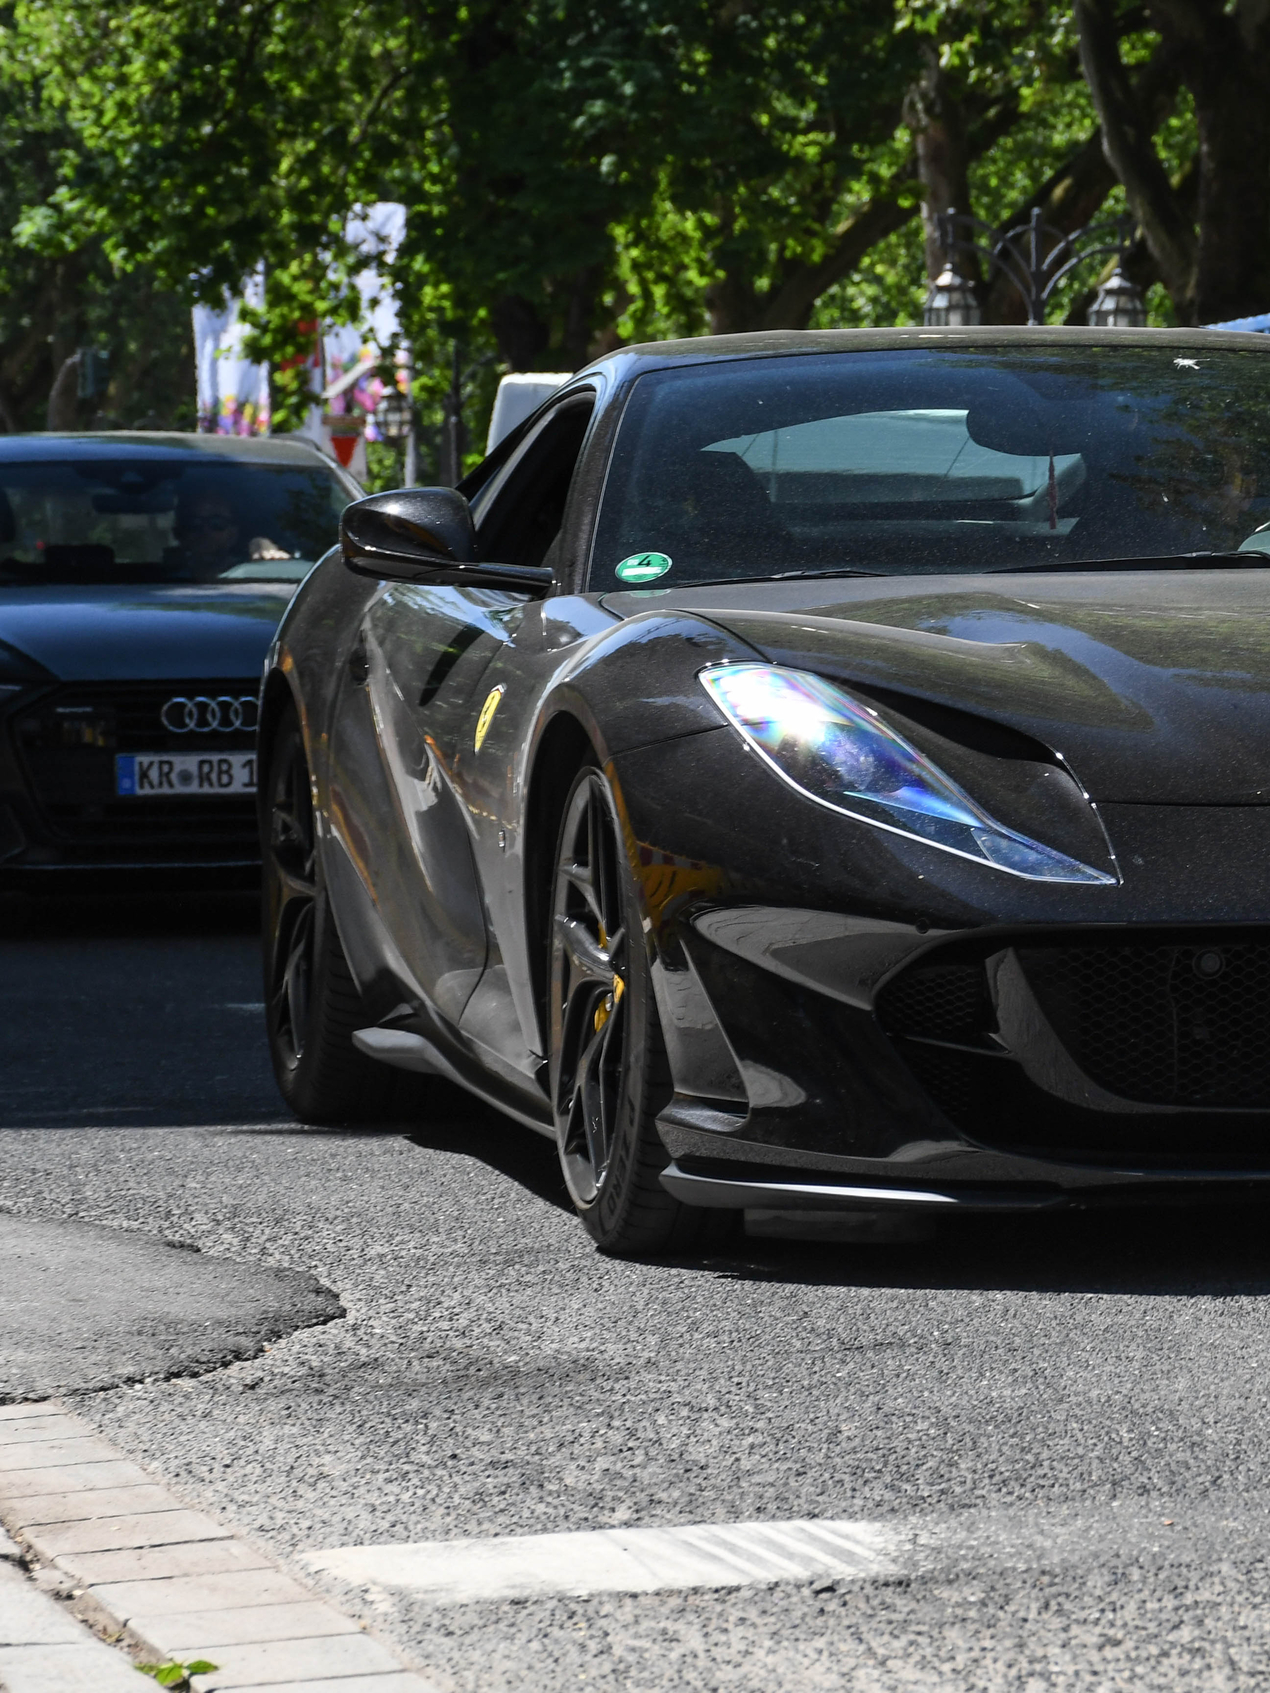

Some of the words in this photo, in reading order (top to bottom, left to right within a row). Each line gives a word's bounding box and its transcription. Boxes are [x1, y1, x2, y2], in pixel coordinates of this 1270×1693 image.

[637, 555, 652, 567] 4
[138, 760, 174, 789] KR
[197, 758, 234, 788] RB
